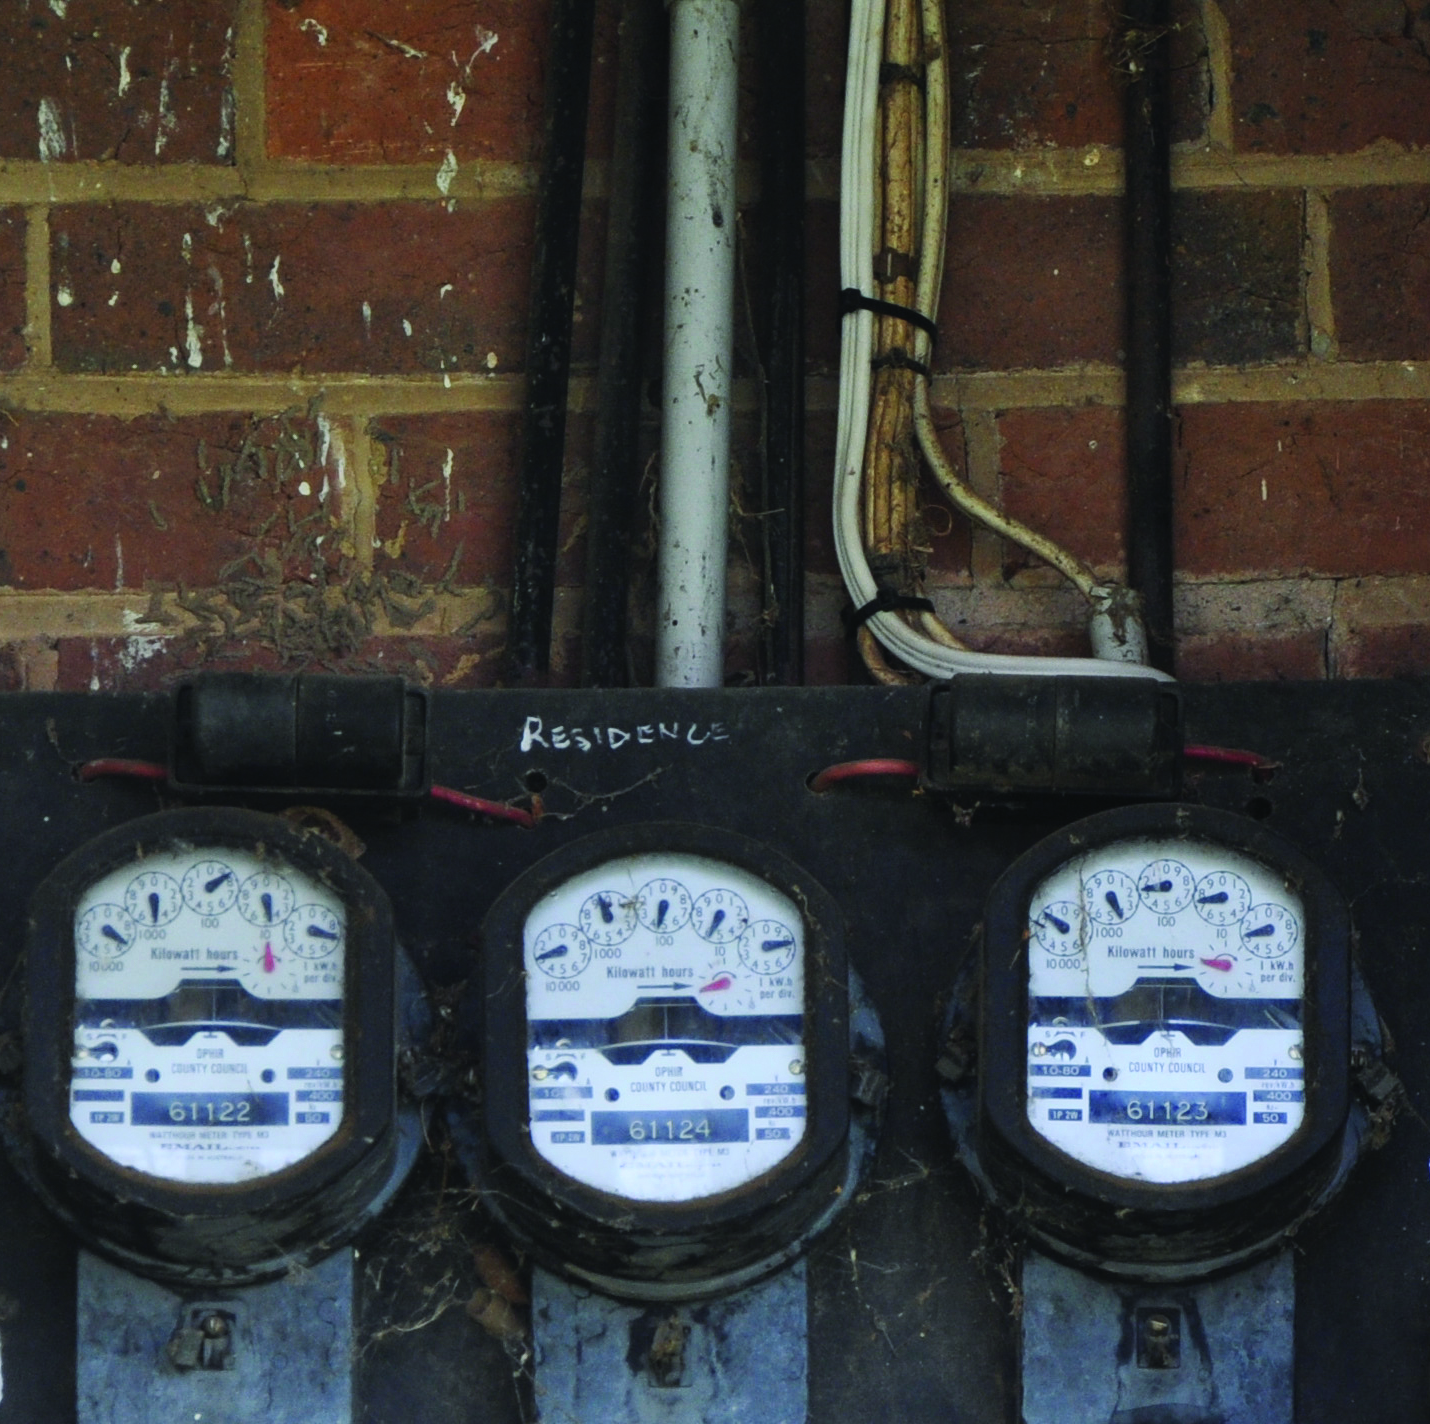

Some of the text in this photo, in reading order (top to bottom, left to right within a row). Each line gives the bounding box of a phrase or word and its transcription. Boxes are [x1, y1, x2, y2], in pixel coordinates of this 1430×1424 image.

[521, 716, 730, 752] RESIDENCE
[1157, 916, 1175, 927] 100
[1095, 927, 1123, 938] 1000
[1216, 928, 1227, 938] 10
[655, 936, 673, 946] 100
[151, 948, 238, 960] Kilowatt hours
[593, 948, 622, 959] 1000
[1107, 945, 1195, 959] Kilowatt hours
[606, 966, 693, 978] Kilowatt hours
[1260, 972, 1296, 984] per div.
[759, 989, 776, 1000] per
[196, 1048, 224, 1059] OPHIR
[171, 1063, 248, 1074] COUNTY COUNCIL
[1042, 1065, 1079, 1076] 10-80
[1129, 1062, 1206, 1074] COUNTY COUNCIL
[1263, 1069, 1288, 1078] 240
[630, 1080, 707, 1092] COUNTY COUNCIL
[1266, 1091, 1292, 1101] 400
[169, 1102, 251, 1122] 61122
[1126, 1100, 1208, 1120] 61123
[1262, 1113, 1279, 1123] 50
[629, 1119, 711, 1140] 61124
[1107, 1129, 1227, 1138] WATTHOUR METER TYPE M3
